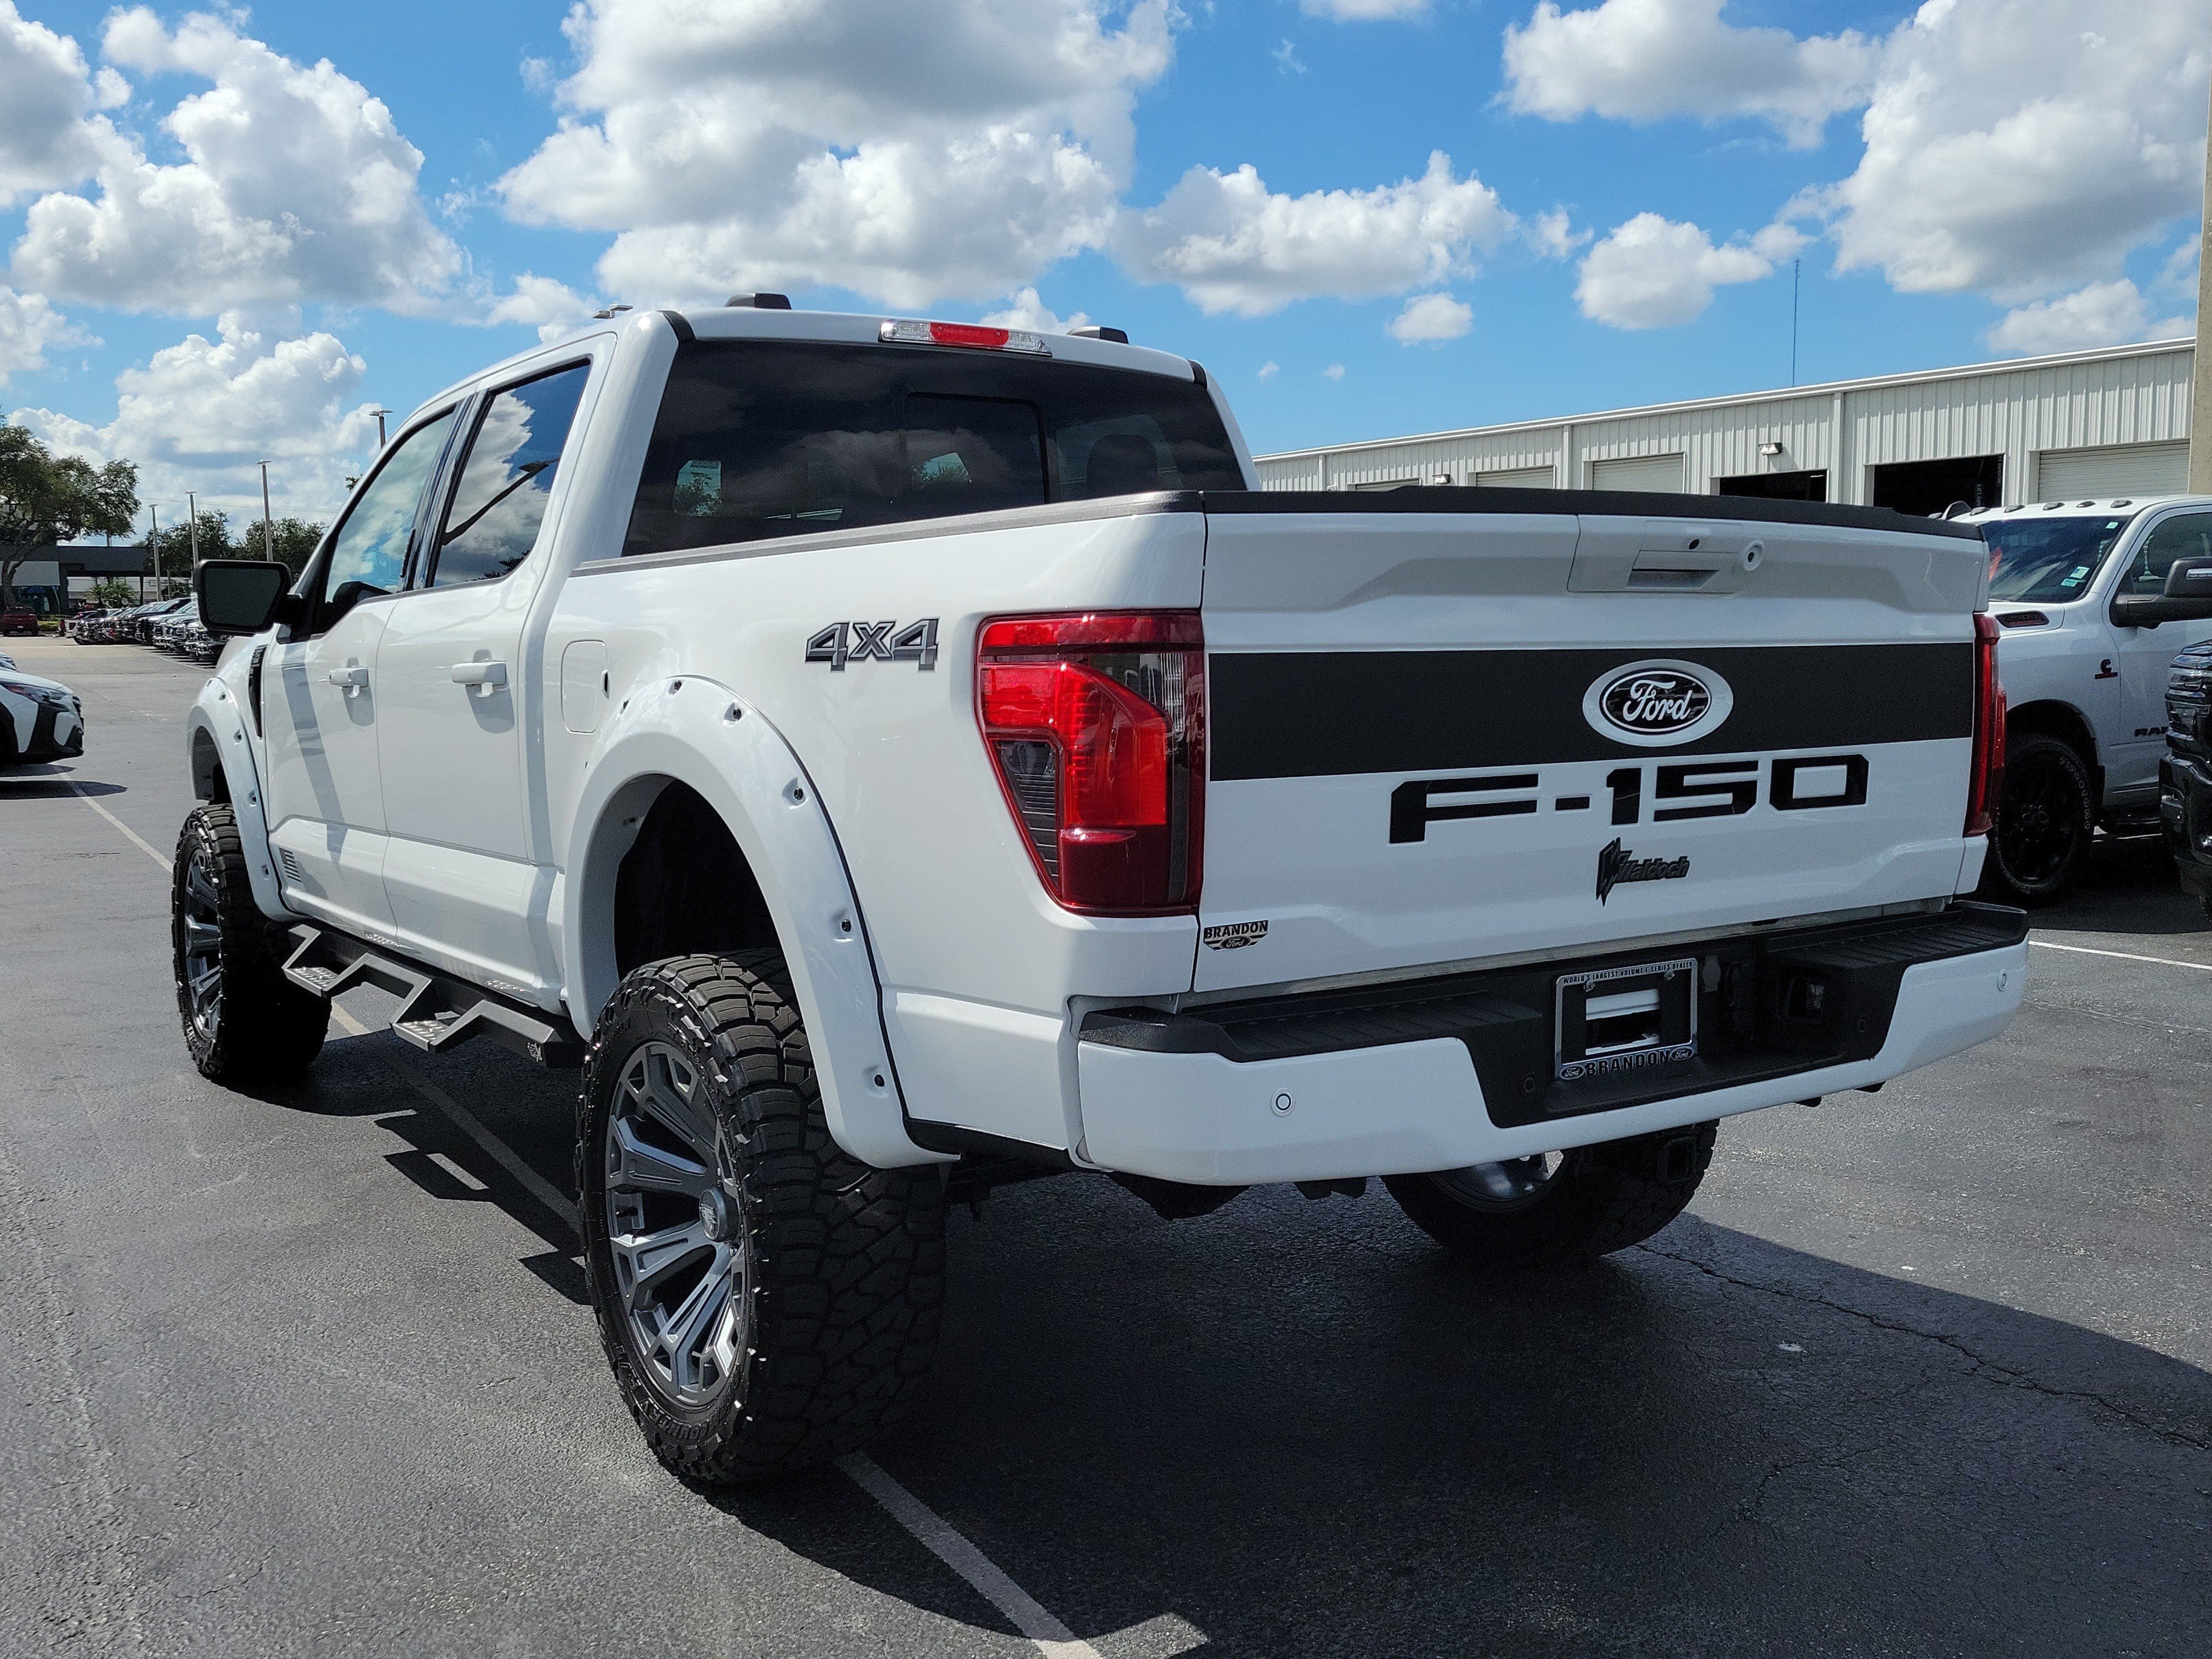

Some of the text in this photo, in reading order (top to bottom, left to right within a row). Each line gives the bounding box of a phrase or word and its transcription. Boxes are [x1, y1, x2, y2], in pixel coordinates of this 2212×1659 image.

[1622, 680, 1691, 721] Ford
[1389, 754, 1870, 844] F-150
[1205, 921, 1268, 939] BRANDON
[1593, 970, 1618, 980] LARGEST
[1620, 967, 1643, 977] VOLUME
[1672, 961, 1692, 969] DEALER
[1565, 1048, 1689, 1077] Ford BRANDON Ford
